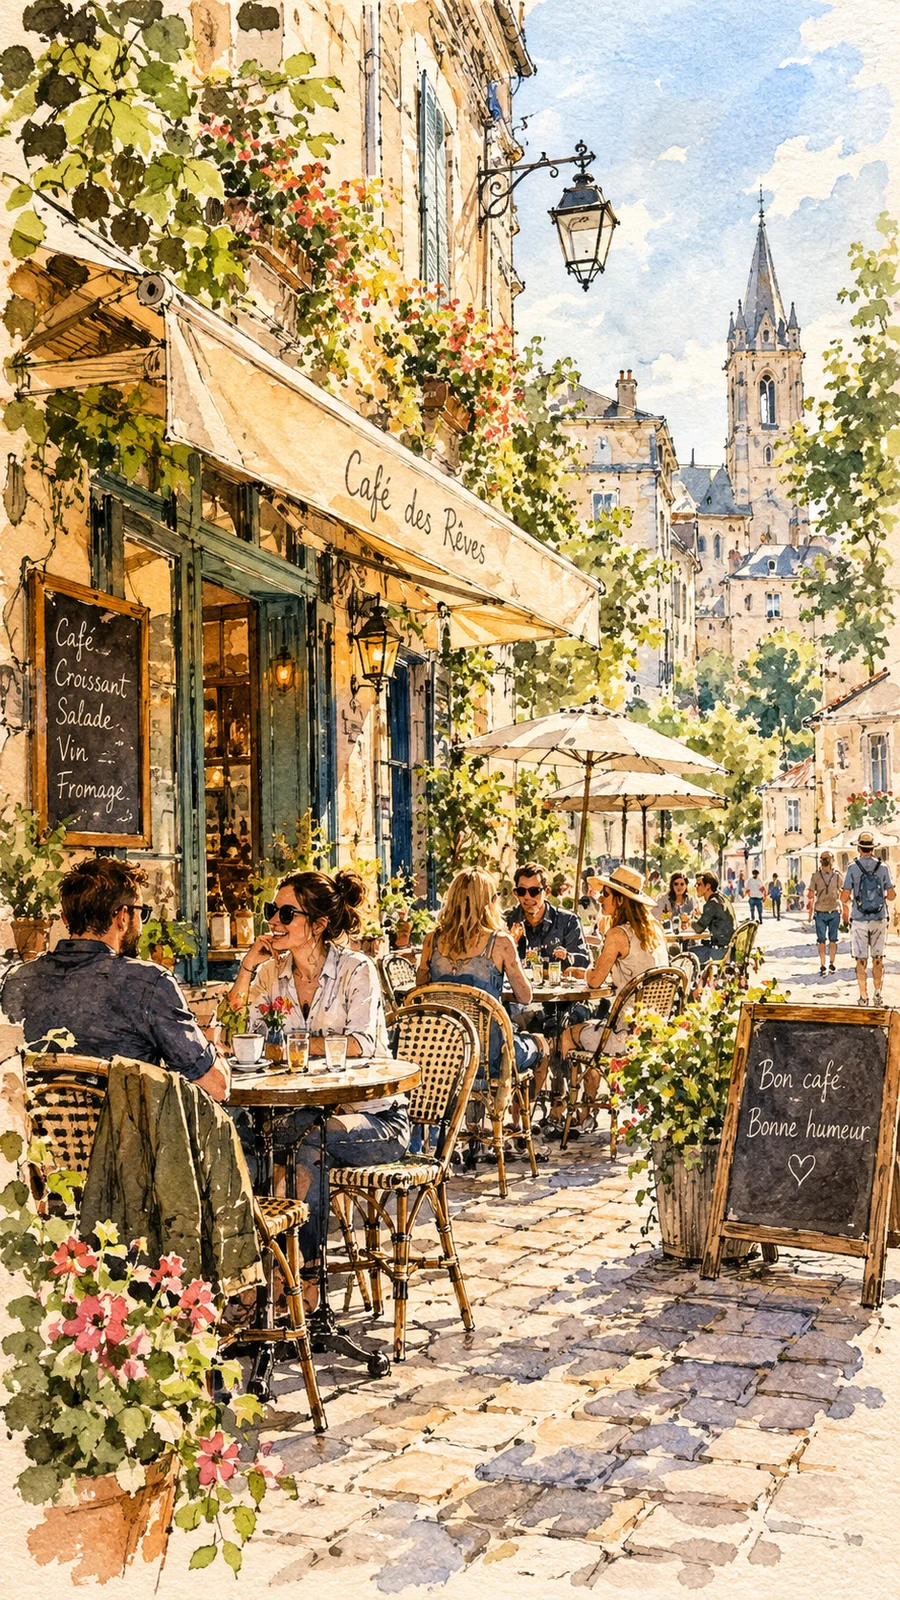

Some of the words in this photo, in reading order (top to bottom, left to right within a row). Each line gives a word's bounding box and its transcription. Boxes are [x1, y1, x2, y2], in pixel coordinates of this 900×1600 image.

[345, 449, 392, 523] Café
[404, 488, 432, 535] des
[443, 507, 486, 565] Rêves
[55, 617, 96, 662] Café
[55, 657, 132, 699] Croissant
[55, 696, 114, 730] Salade
[56, 734, 89, 762] Vin
[758, 1058, 794, 1091] Bon
[746, 1106, 798, 1138] Bonne
